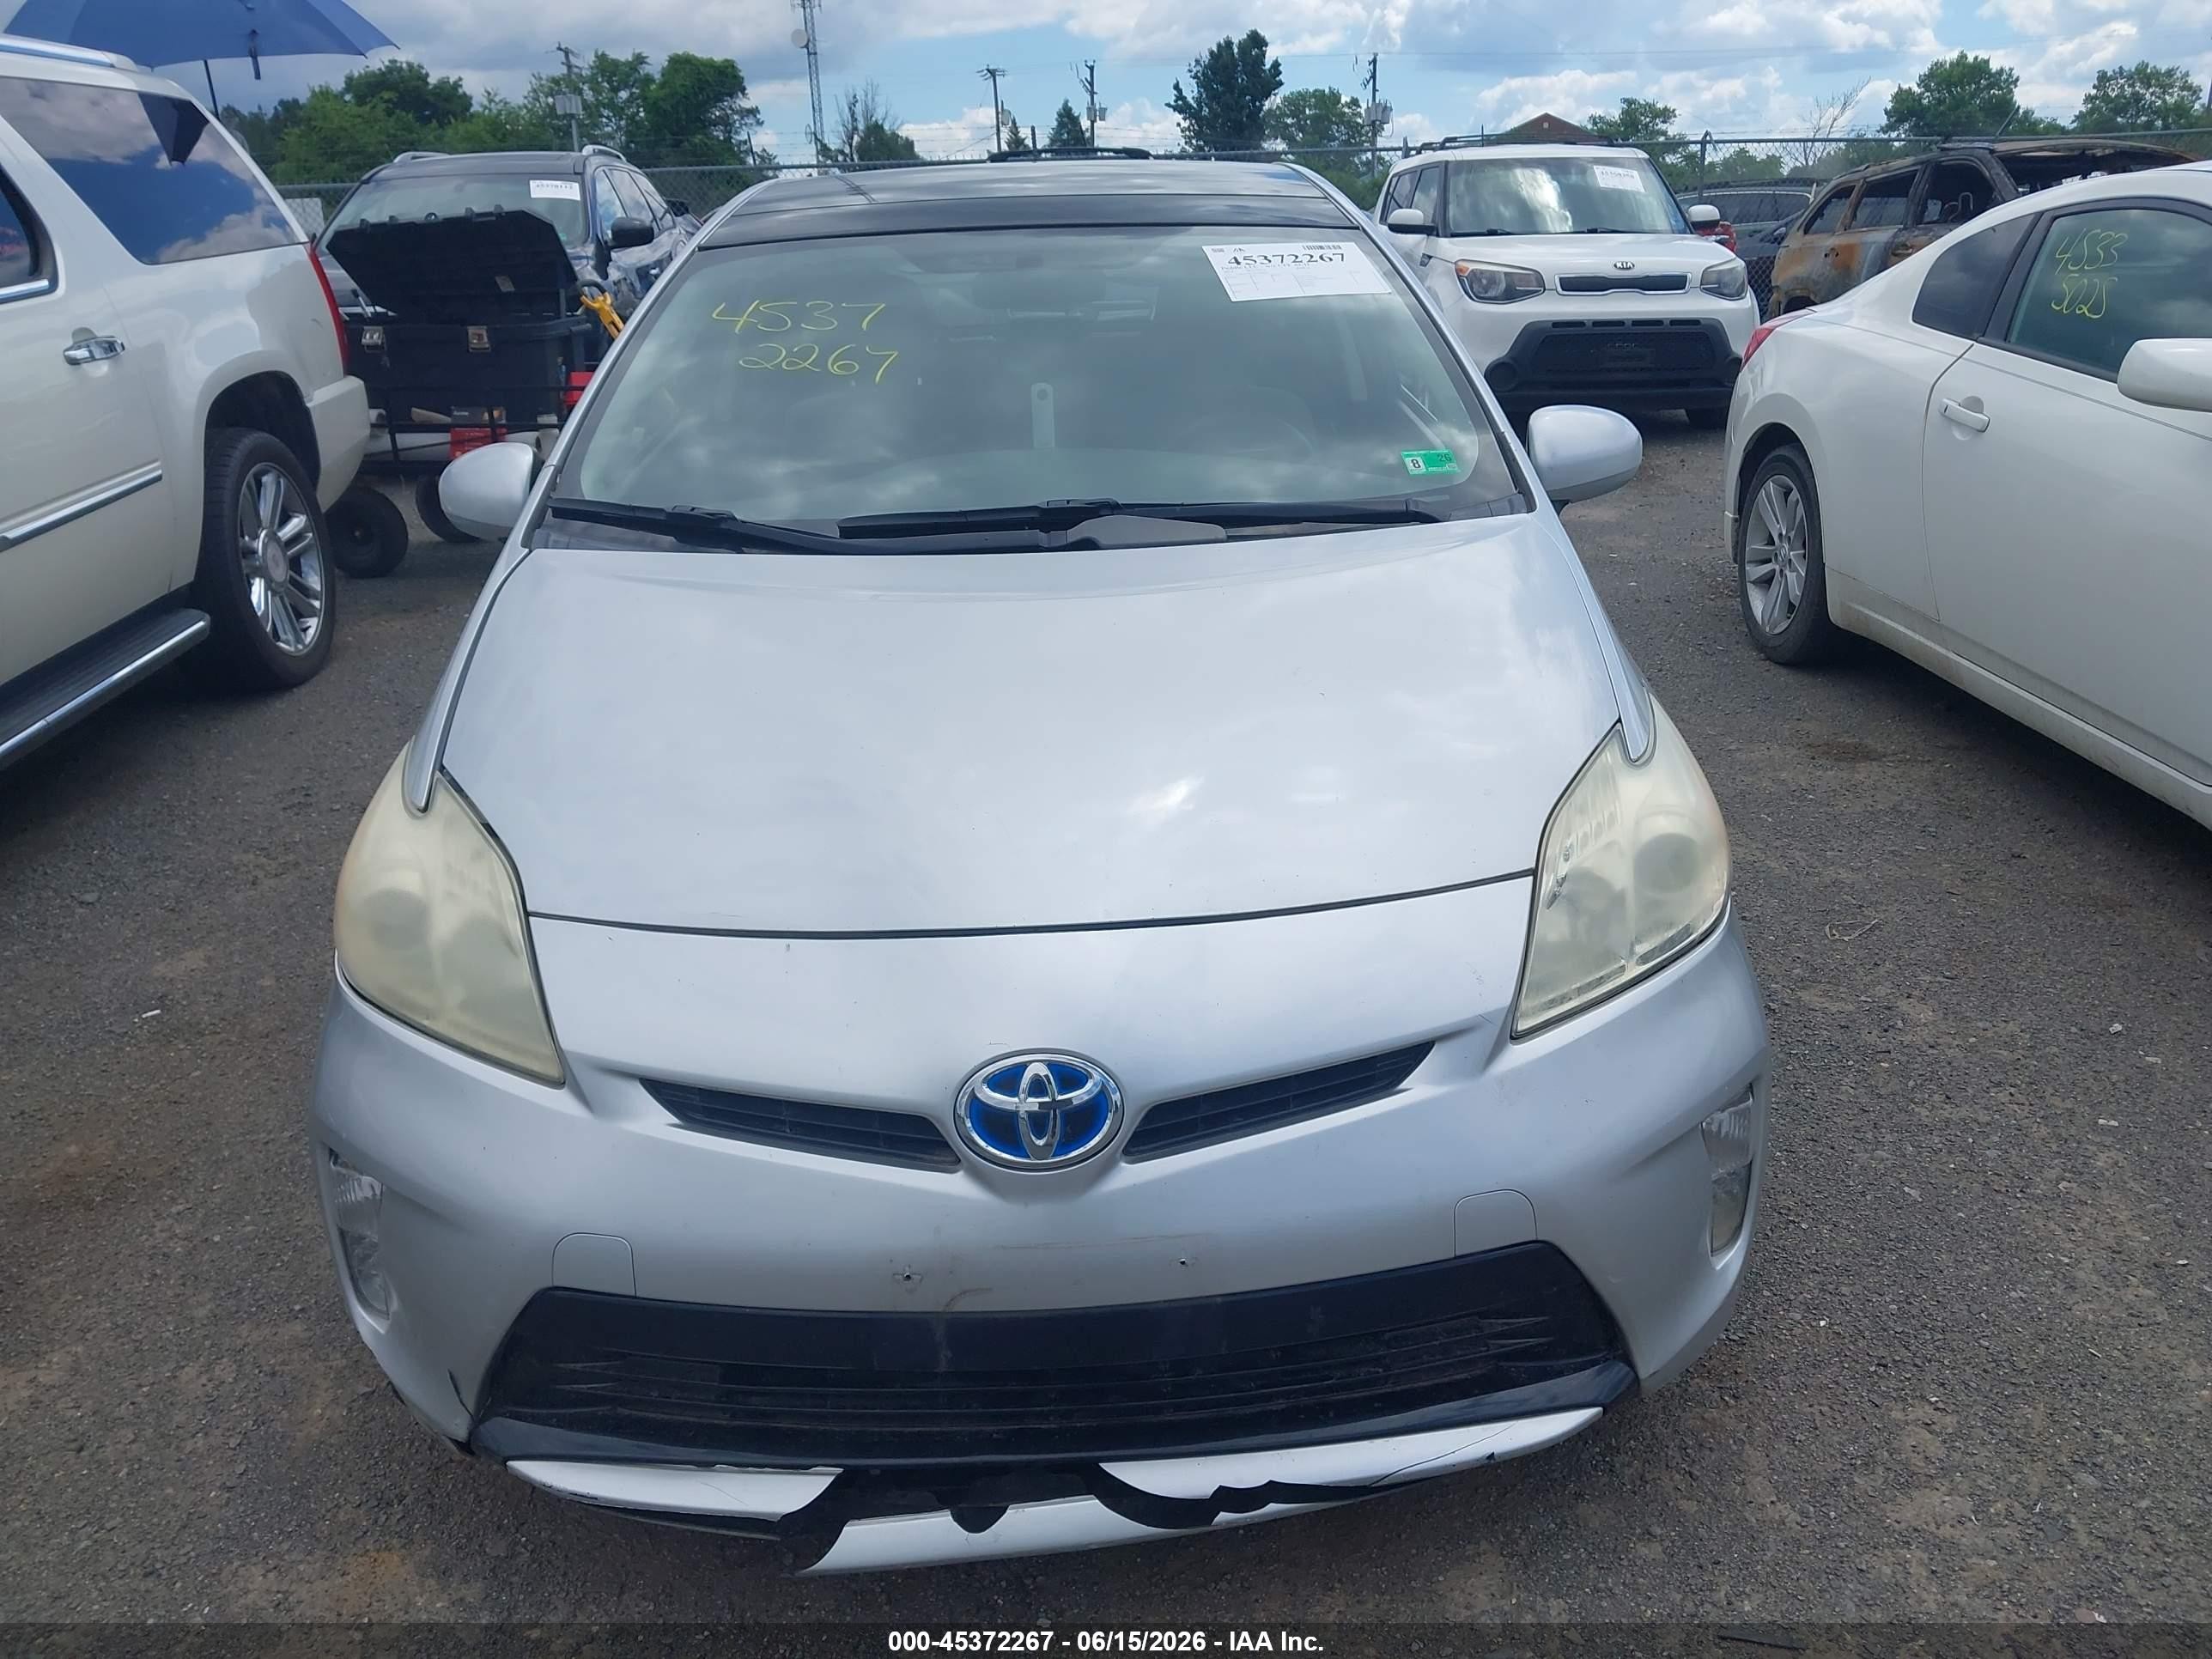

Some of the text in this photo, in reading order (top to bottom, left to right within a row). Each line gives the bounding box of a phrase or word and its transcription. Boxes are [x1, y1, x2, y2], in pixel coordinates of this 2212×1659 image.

[1227, 252, 1346, 266] 45372267
[2055, 228, 2128, 275] 4533
[1614, 260, 1634, 269] KIA
[711, 300, 886, 334] 4537
[738, 343, 899, 385] 2267
[1410, 459, 1421, 469] 8
